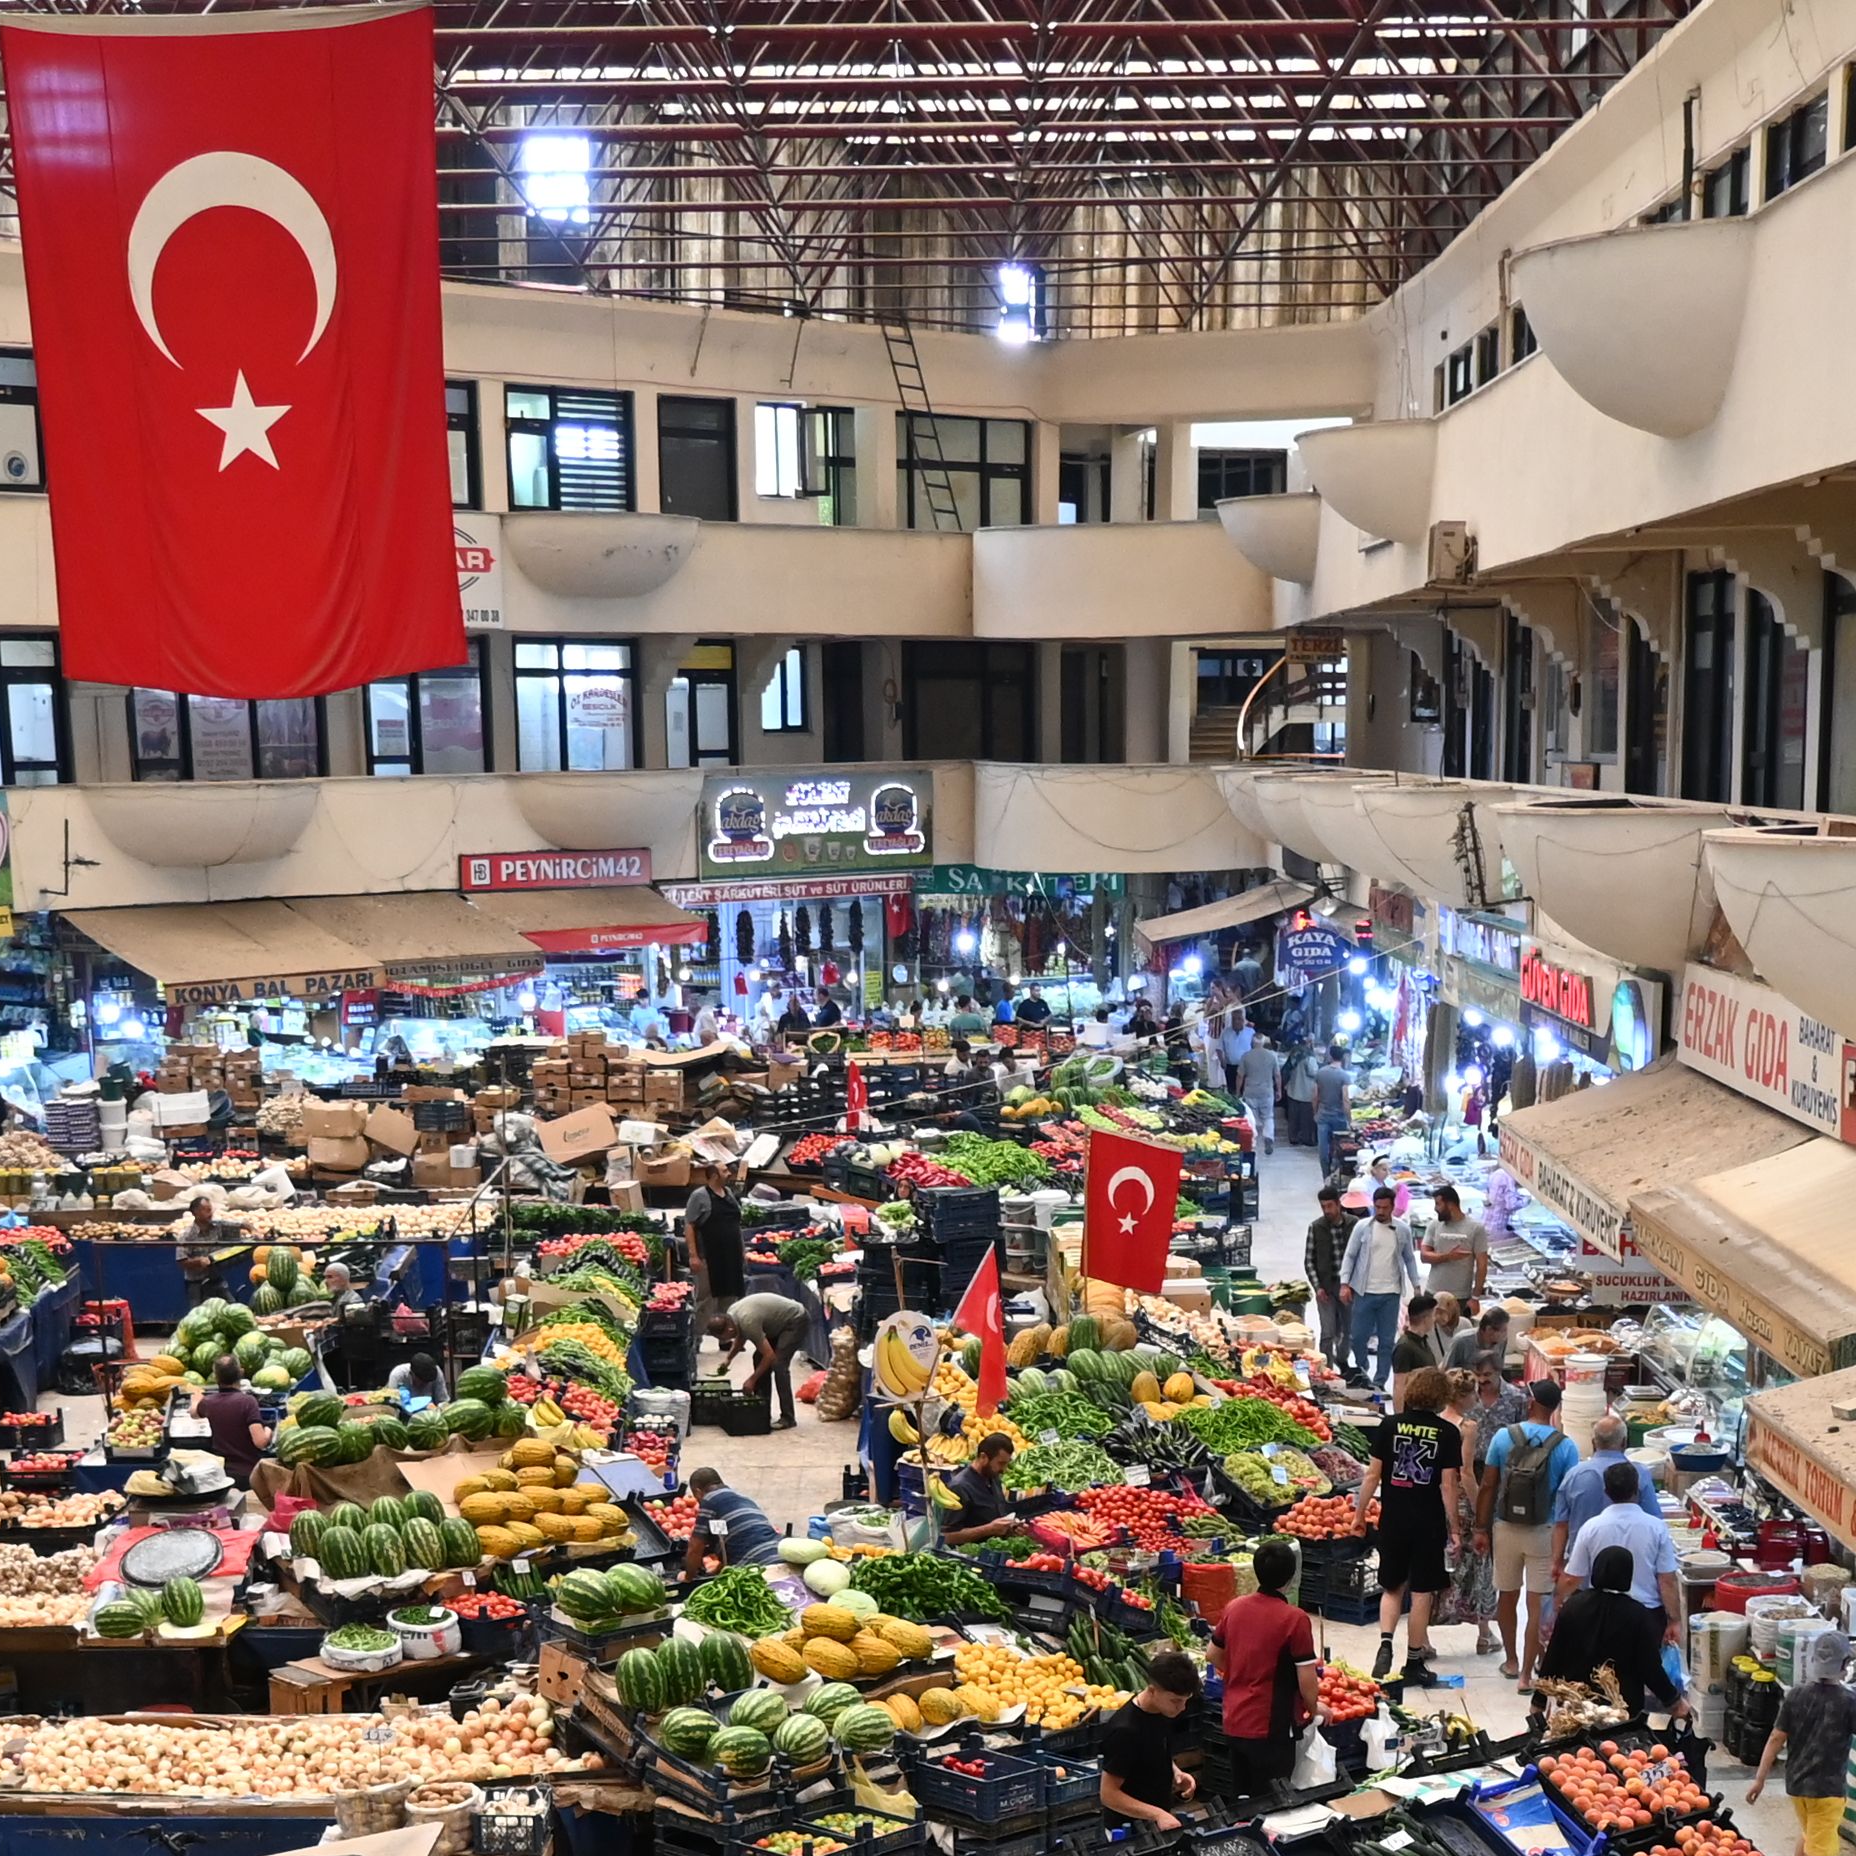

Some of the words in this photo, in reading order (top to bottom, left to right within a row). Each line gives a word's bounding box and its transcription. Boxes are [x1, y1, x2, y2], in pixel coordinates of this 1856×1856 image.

[785, 882, 808, 897] SÜT
[810, 885, 823, 895] ve
[826, 881, 848, 894] SÜT
[852, 877, 908, 893] ÜRÜNLERİ
[1287, 932, 1337, 949] KAYA
[1291, 947, 1332, 958] GIDA
[174, 984, 241, 1005] KONYA
[253, 979, 291, 998] BAL
[304, 972, 375, 994] PAZARI
[1520, 947, 1558, 1011] GÜVEN
[1559, 971, 1590, 1027] GIDA
[1683, 982, 1740, 1070] ERZAK
[1744, 1008, 1789, 1096] GIDA
[1798, 1016, 1836, 1057] BAHARAT
[1811, 1054, 1819, 1084] &
[1791, 1082, 1838, 1131] KURUYEMİŞ
[1596, 1275, 1661, 1287] SUCUKLUK
[1693, 1263, 1730, 1312] GIDA
[1397, 1422, 1438, 1439] WHITE
[1804, 1460, 1845, 1526] TOHUM
